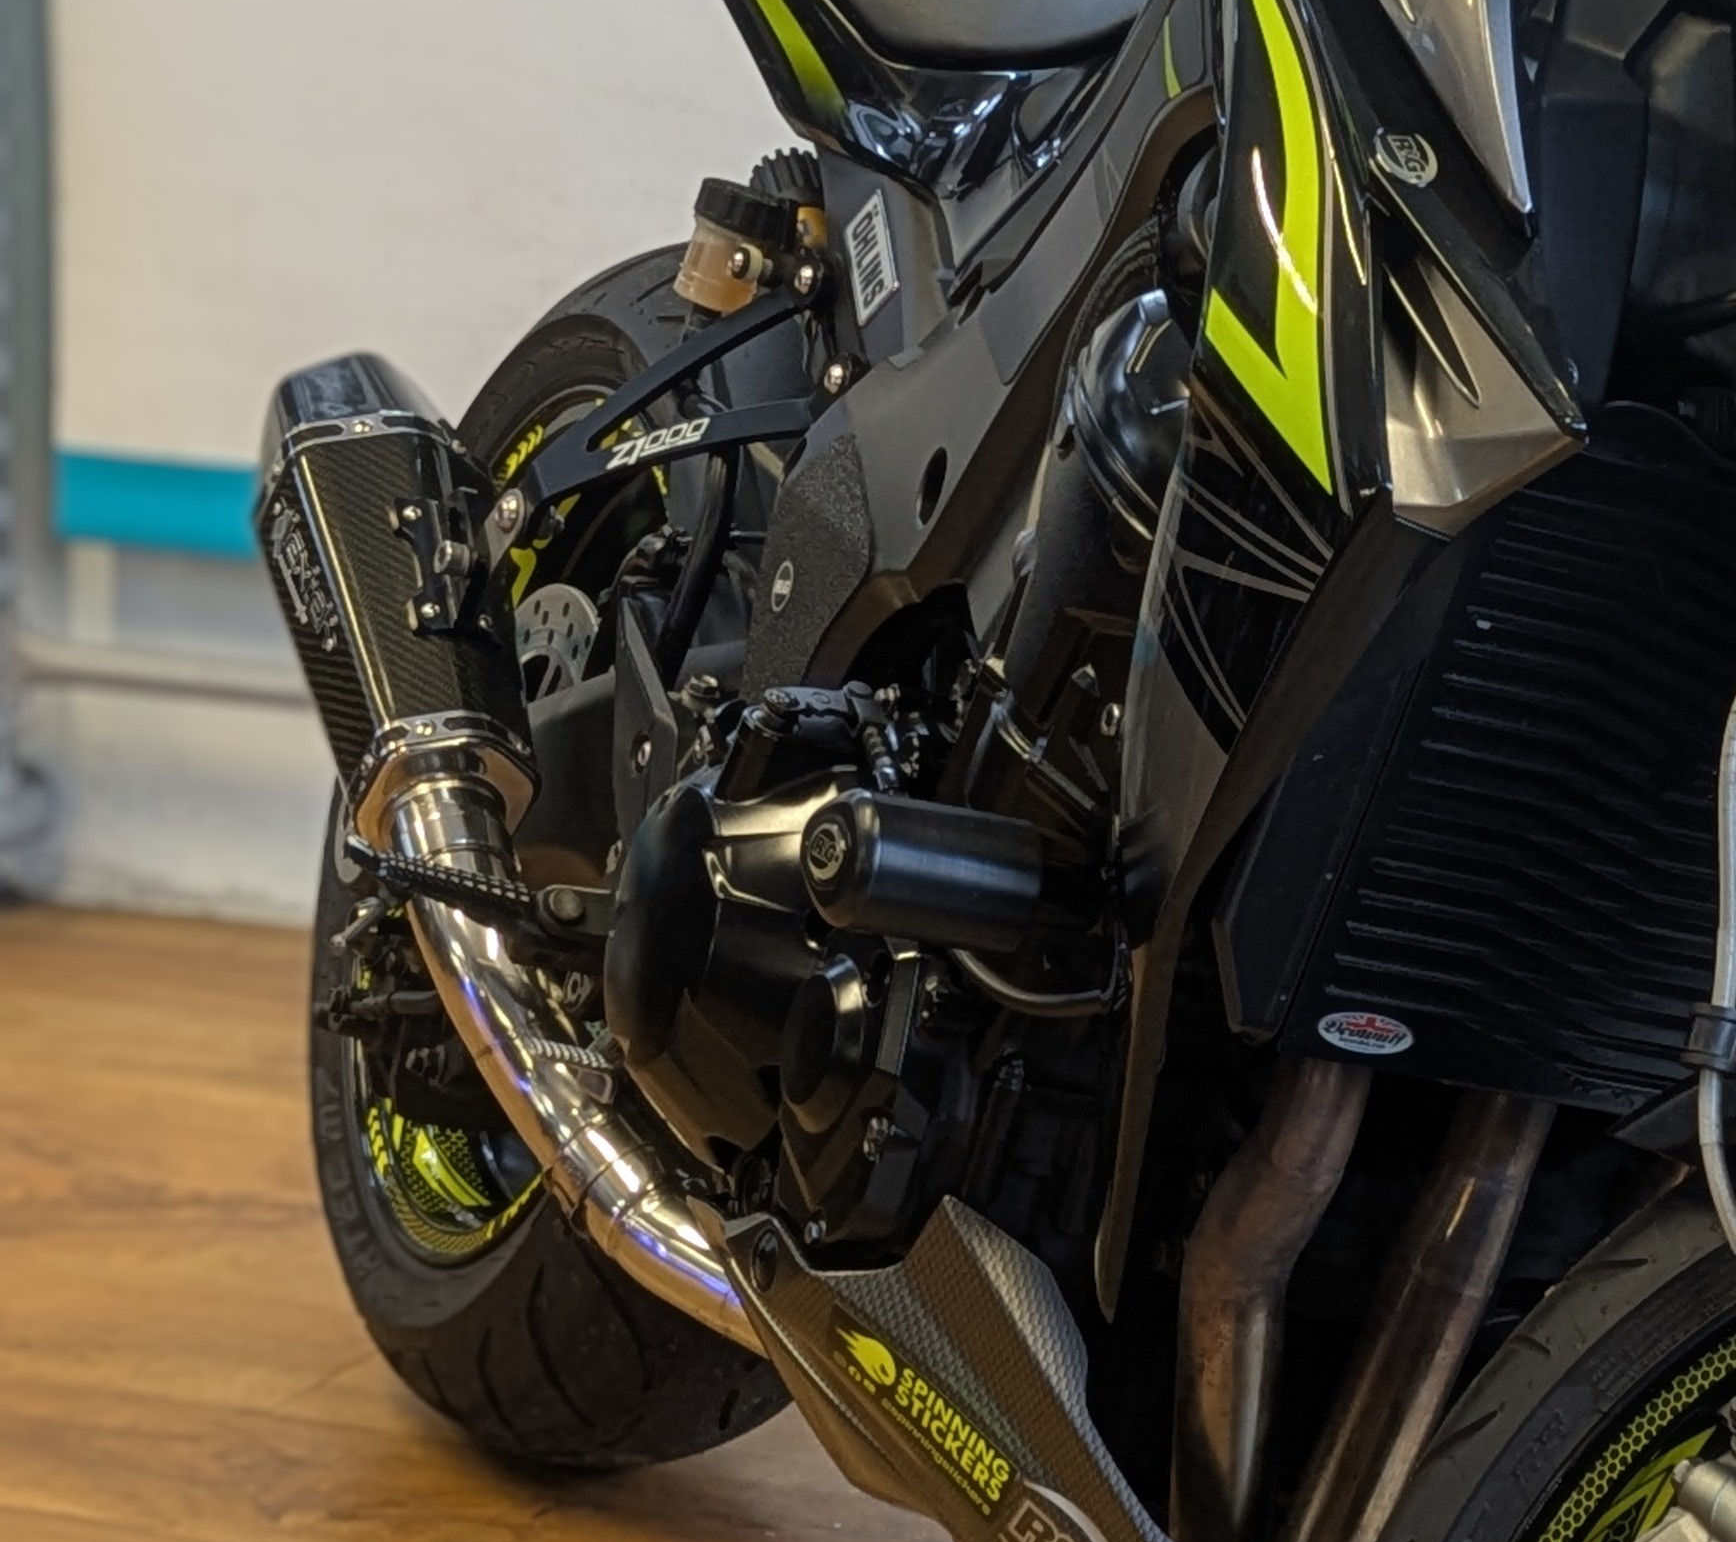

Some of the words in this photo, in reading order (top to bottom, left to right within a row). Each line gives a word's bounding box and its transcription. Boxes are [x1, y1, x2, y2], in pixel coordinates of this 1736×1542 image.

[605, 416, 711, 470] Z1000
[895, 1384, 1003, 1502] STICKERS
[901, 1368, 1010, 1482] SPINNING
